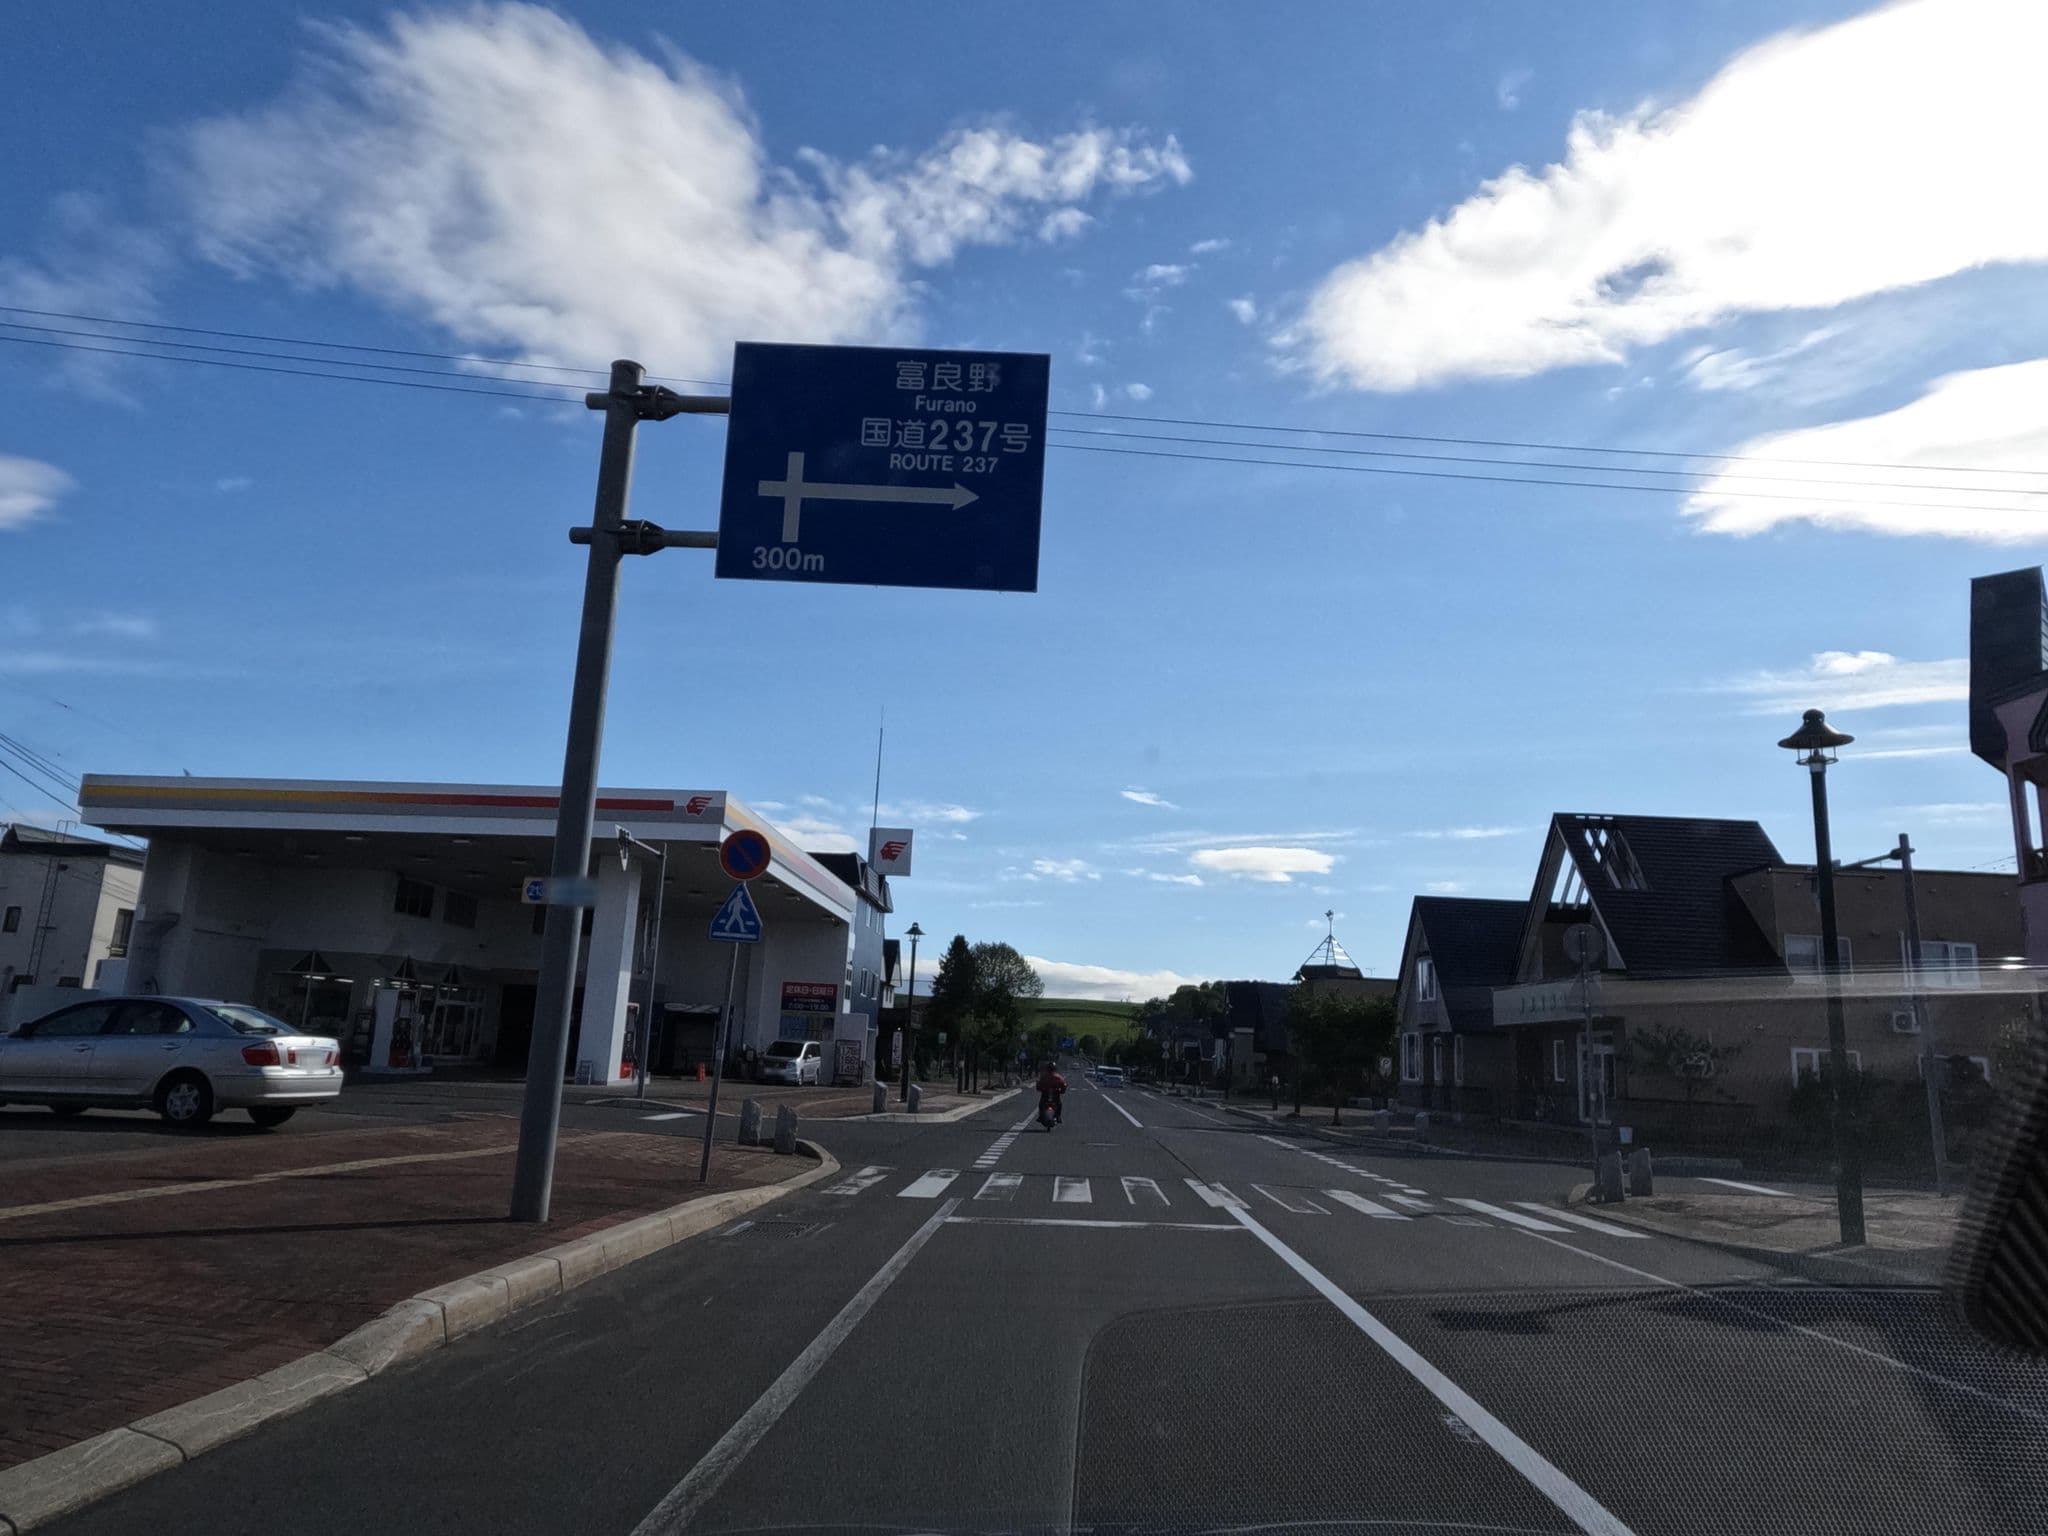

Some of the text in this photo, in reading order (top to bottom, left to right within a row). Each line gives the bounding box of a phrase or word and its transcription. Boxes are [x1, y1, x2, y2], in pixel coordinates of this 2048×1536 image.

[895, 360, 1001, 393] 富良野
[914, 395, 977, 413] Furano
[860, 417, 1032, 454] 国道237号
[889, 453, 999, 473] ROUTE 237
[752, 545, 825, 572] 300m
